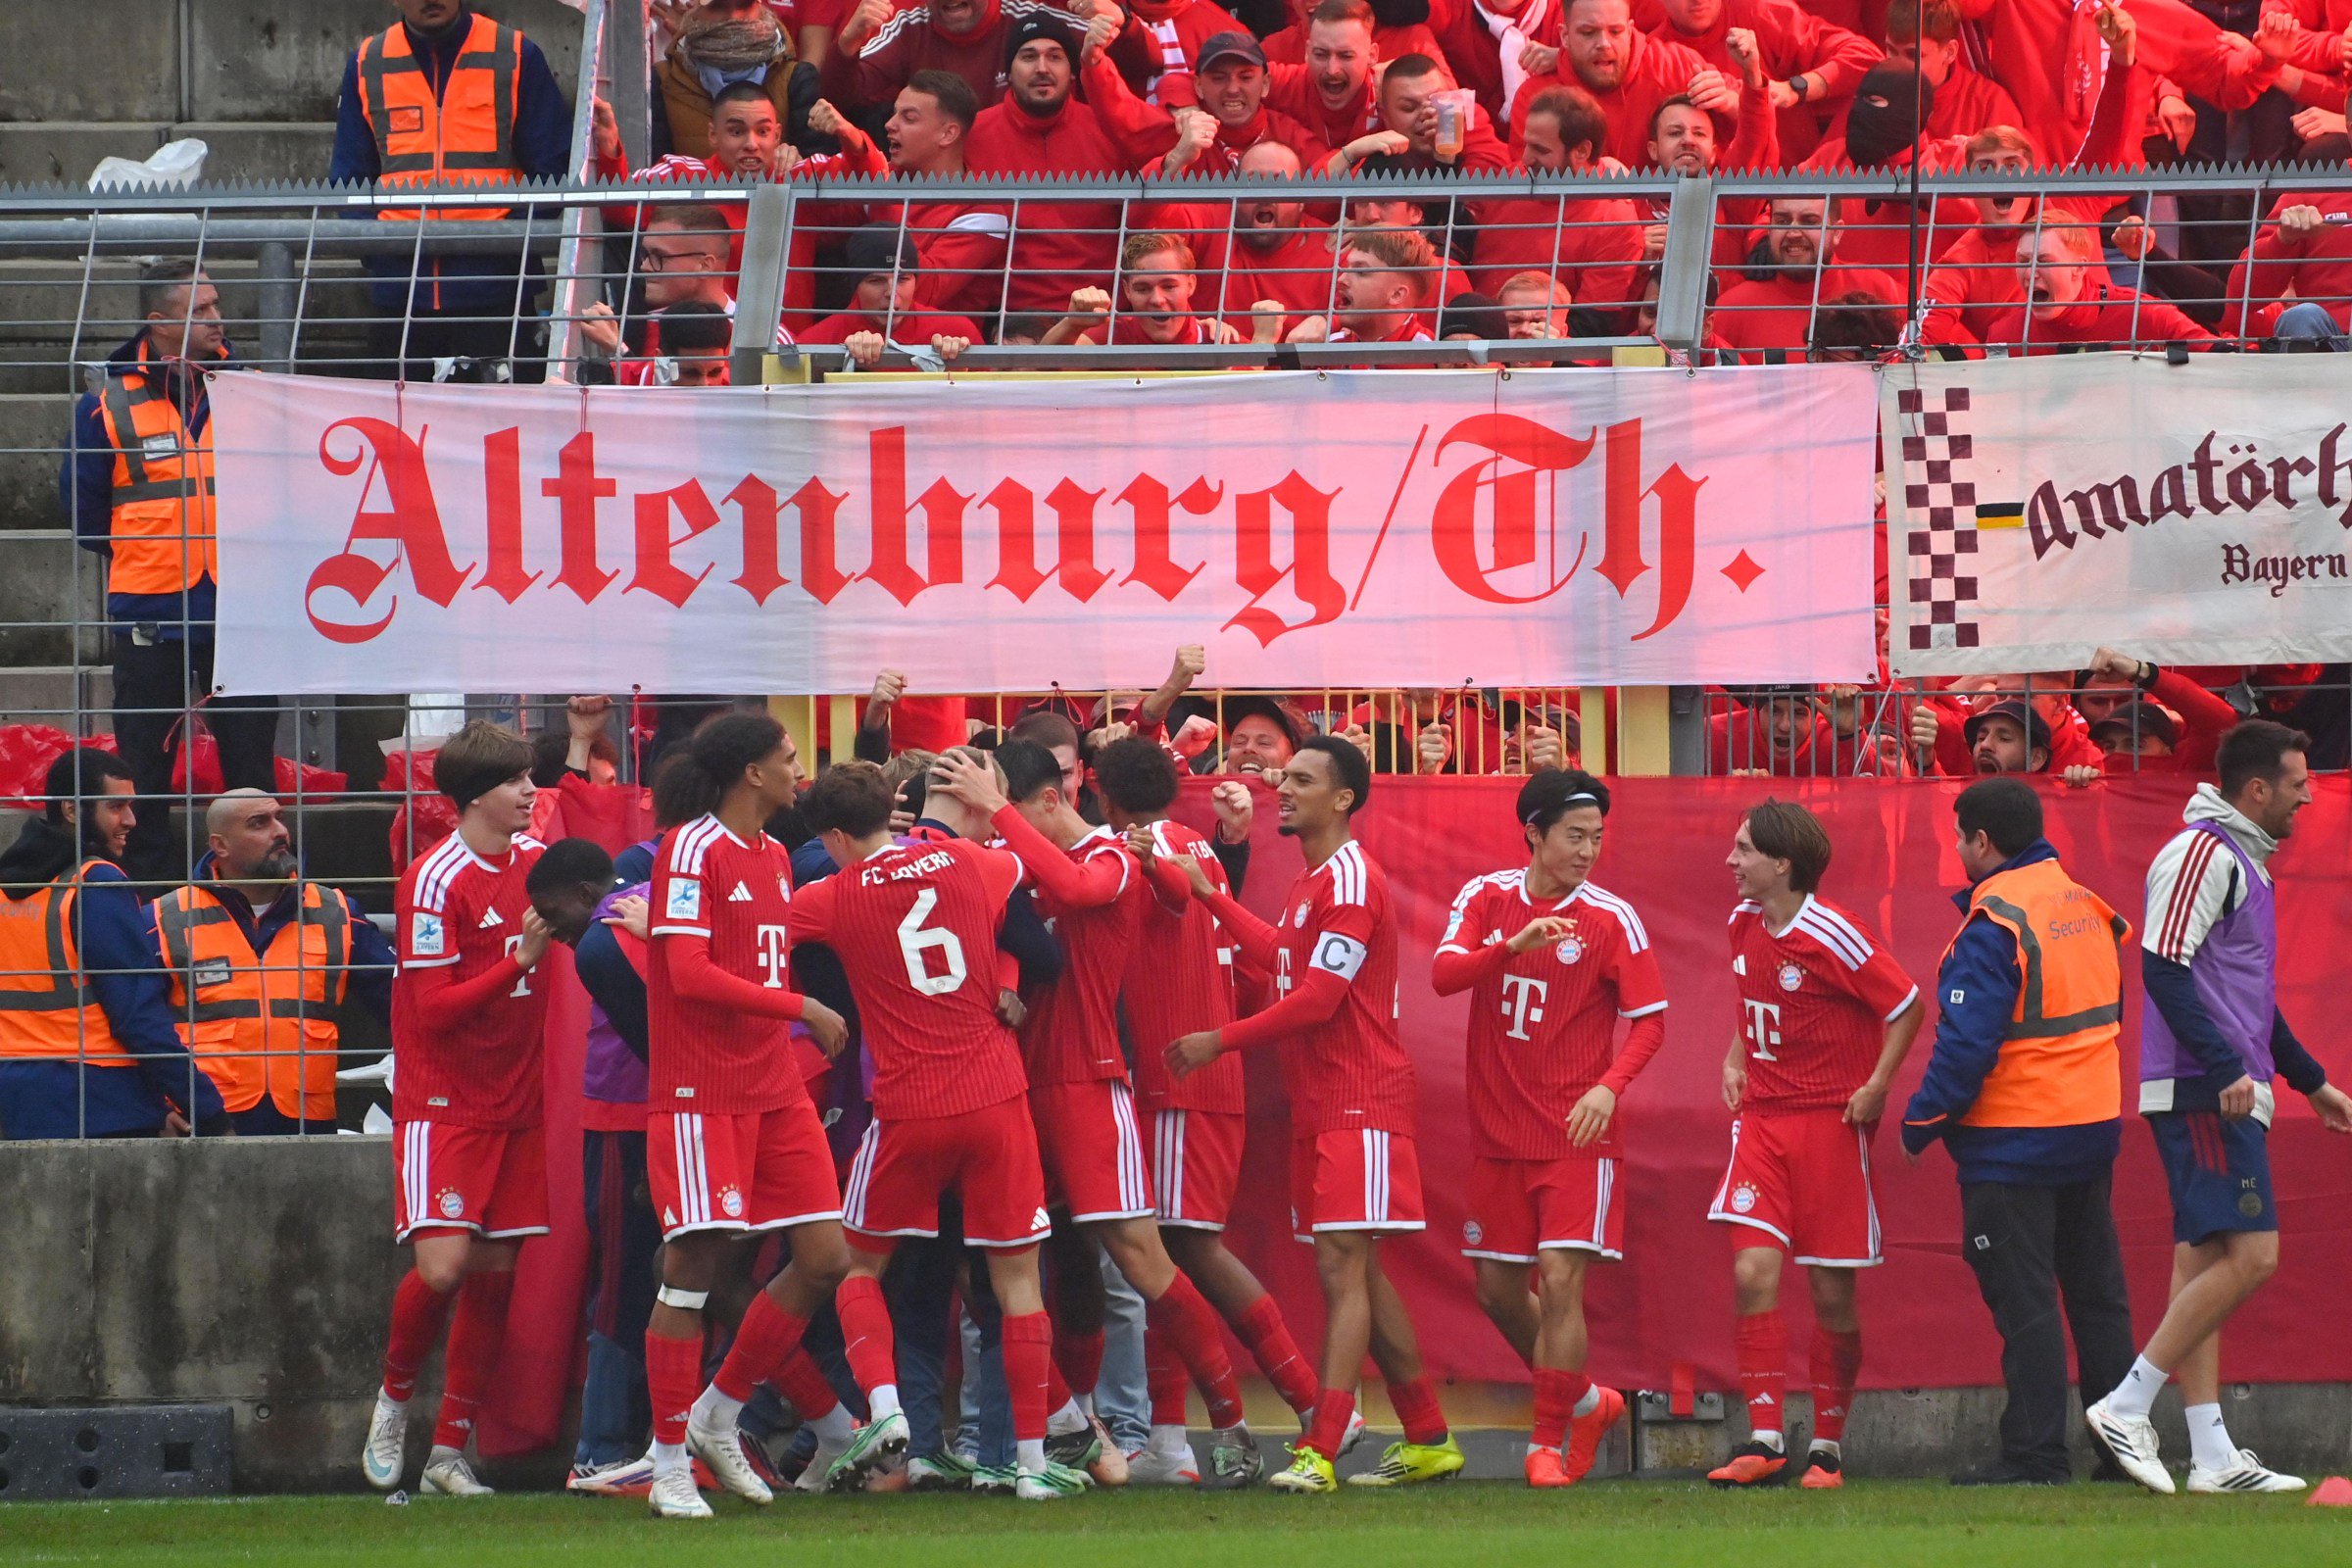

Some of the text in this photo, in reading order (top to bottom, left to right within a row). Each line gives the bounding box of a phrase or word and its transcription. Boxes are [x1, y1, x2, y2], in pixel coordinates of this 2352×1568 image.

[305, 413, 1767, 650] Altenburg/Th.
[2221, 543, 2348, 598] Bayern
[861, 866, 885, 887] FC
[897, 887, 967, 997] 6
[2049, 912, 2102, 940] Security
[1320, 937, 1351, 971] C
[2241, 1177, 2257, 1189] ME
